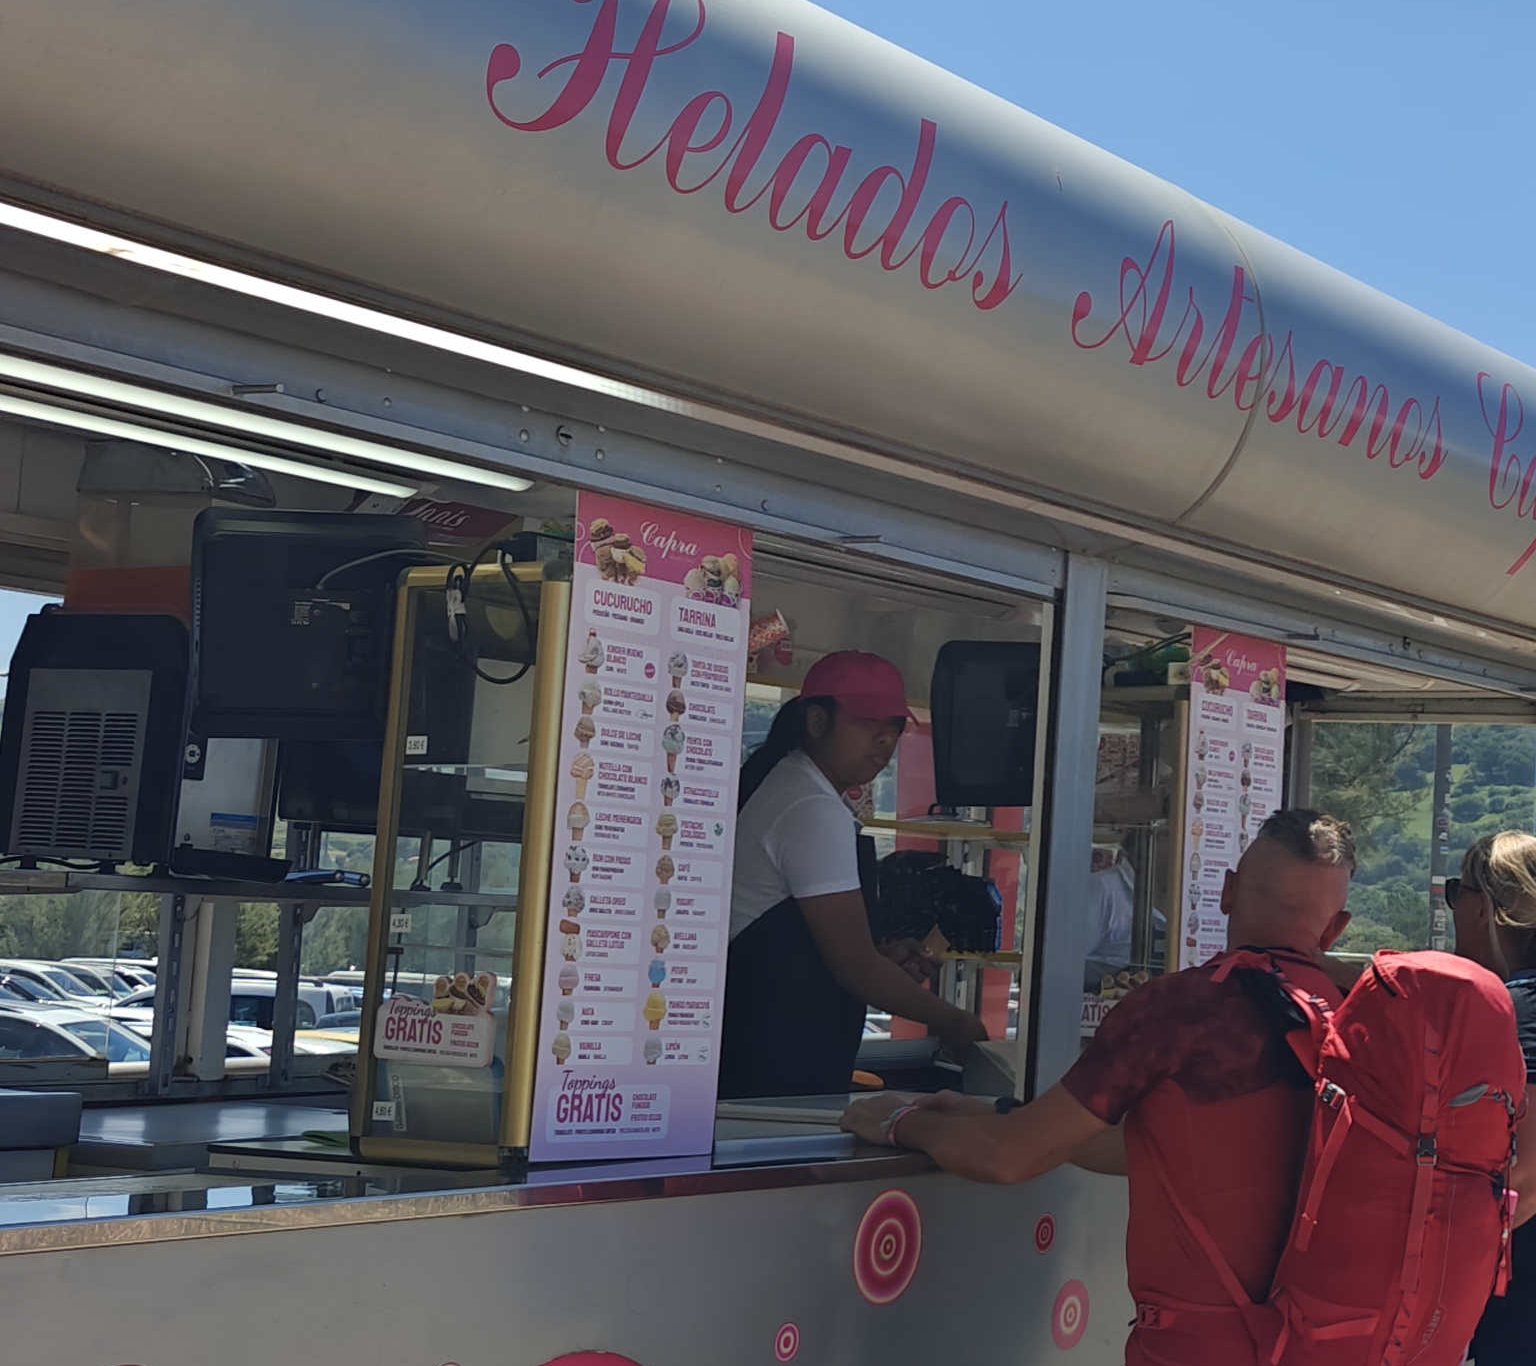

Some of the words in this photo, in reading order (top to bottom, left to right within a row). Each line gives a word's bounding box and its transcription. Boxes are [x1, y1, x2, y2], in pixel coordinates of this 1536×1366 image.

[1071, 219, 1449, 480] Artesanos
[640, 521, 699, 559] Capra
[593, 589, 653, 616] CUCURUCHO
[678, 607, 717, 628] TARRINA
[389, 996, 437, 1020] Toppings
[1081, 1004, 1110, 1022] ATIS
[385, 1016, 443, 1045] GRATIS
[561, 1069, 617, 1095] Toppings
[556, 1093, 623, 1124] GRATIS
